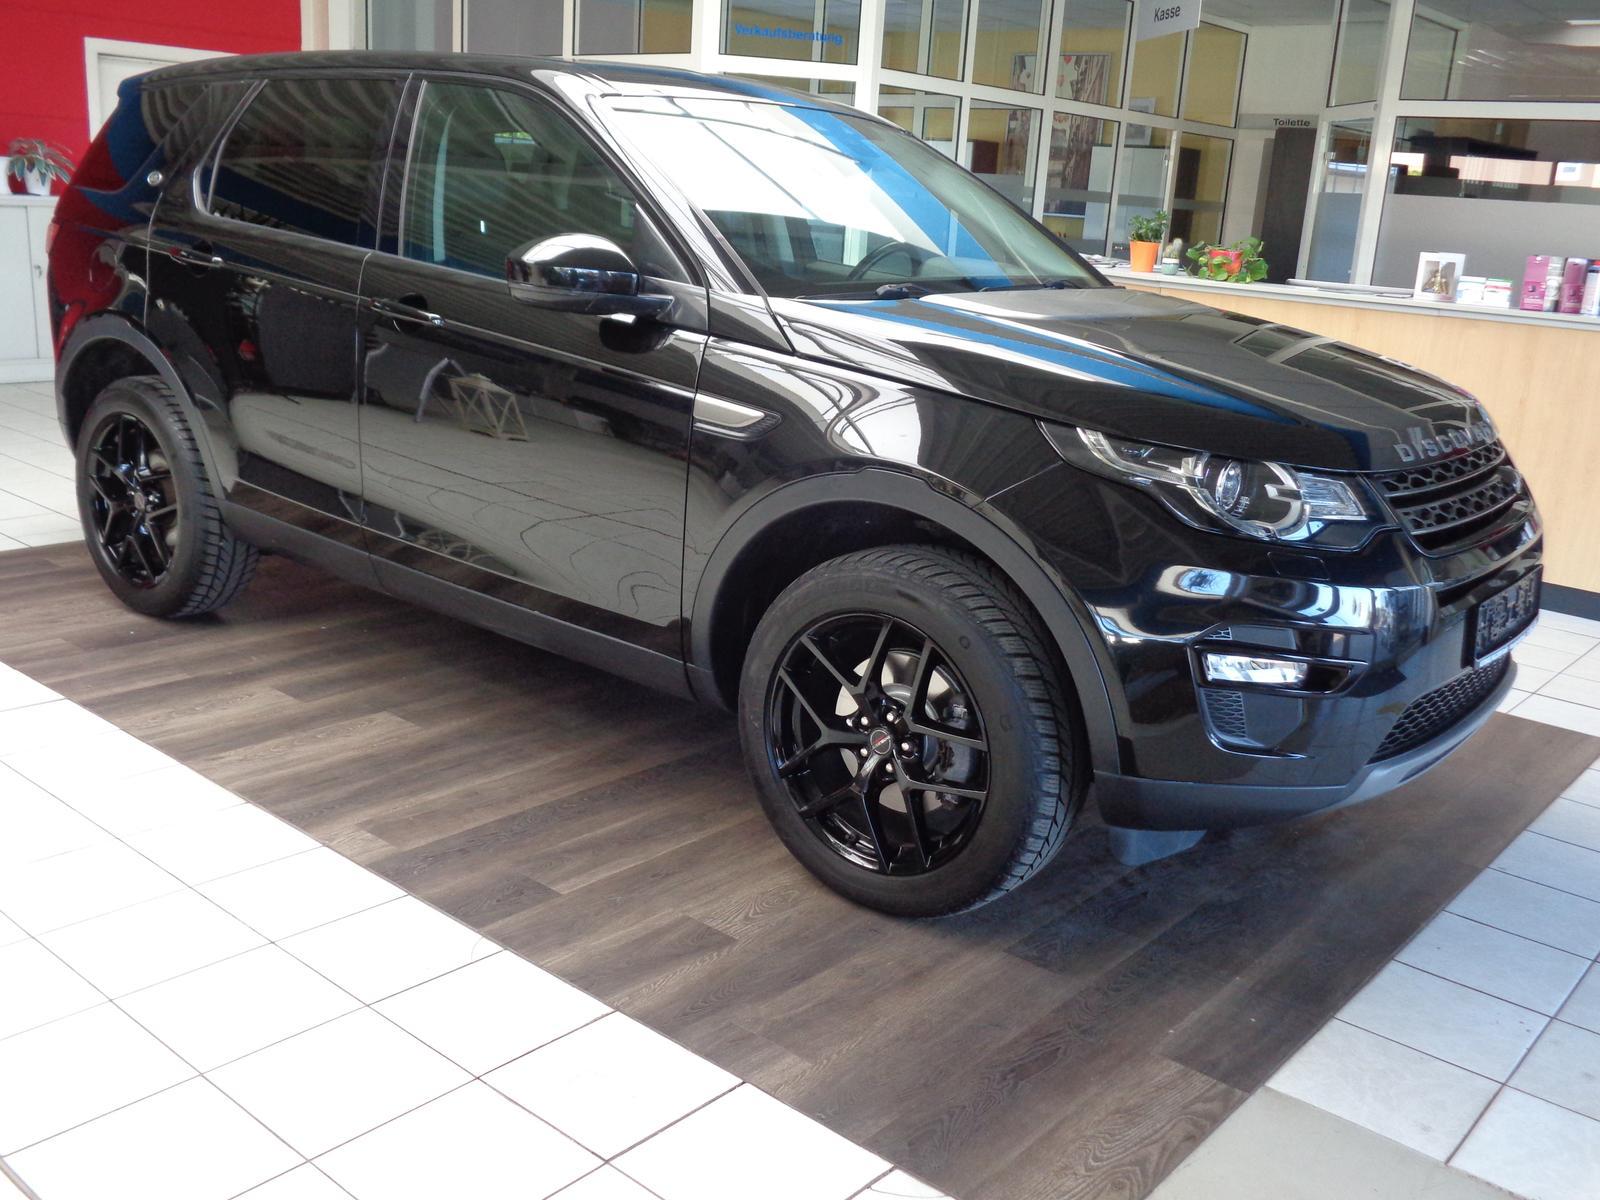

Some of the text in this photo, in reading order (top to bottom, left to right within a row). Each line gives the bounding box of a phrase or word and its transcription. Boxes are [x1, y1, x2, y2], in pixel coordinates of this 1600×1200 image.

[1153, 5, 1181, 22] Kasse
[735, 23, 844, 46] Verkaufsberatung
[1273, 117, 1311, 127] Toilette
